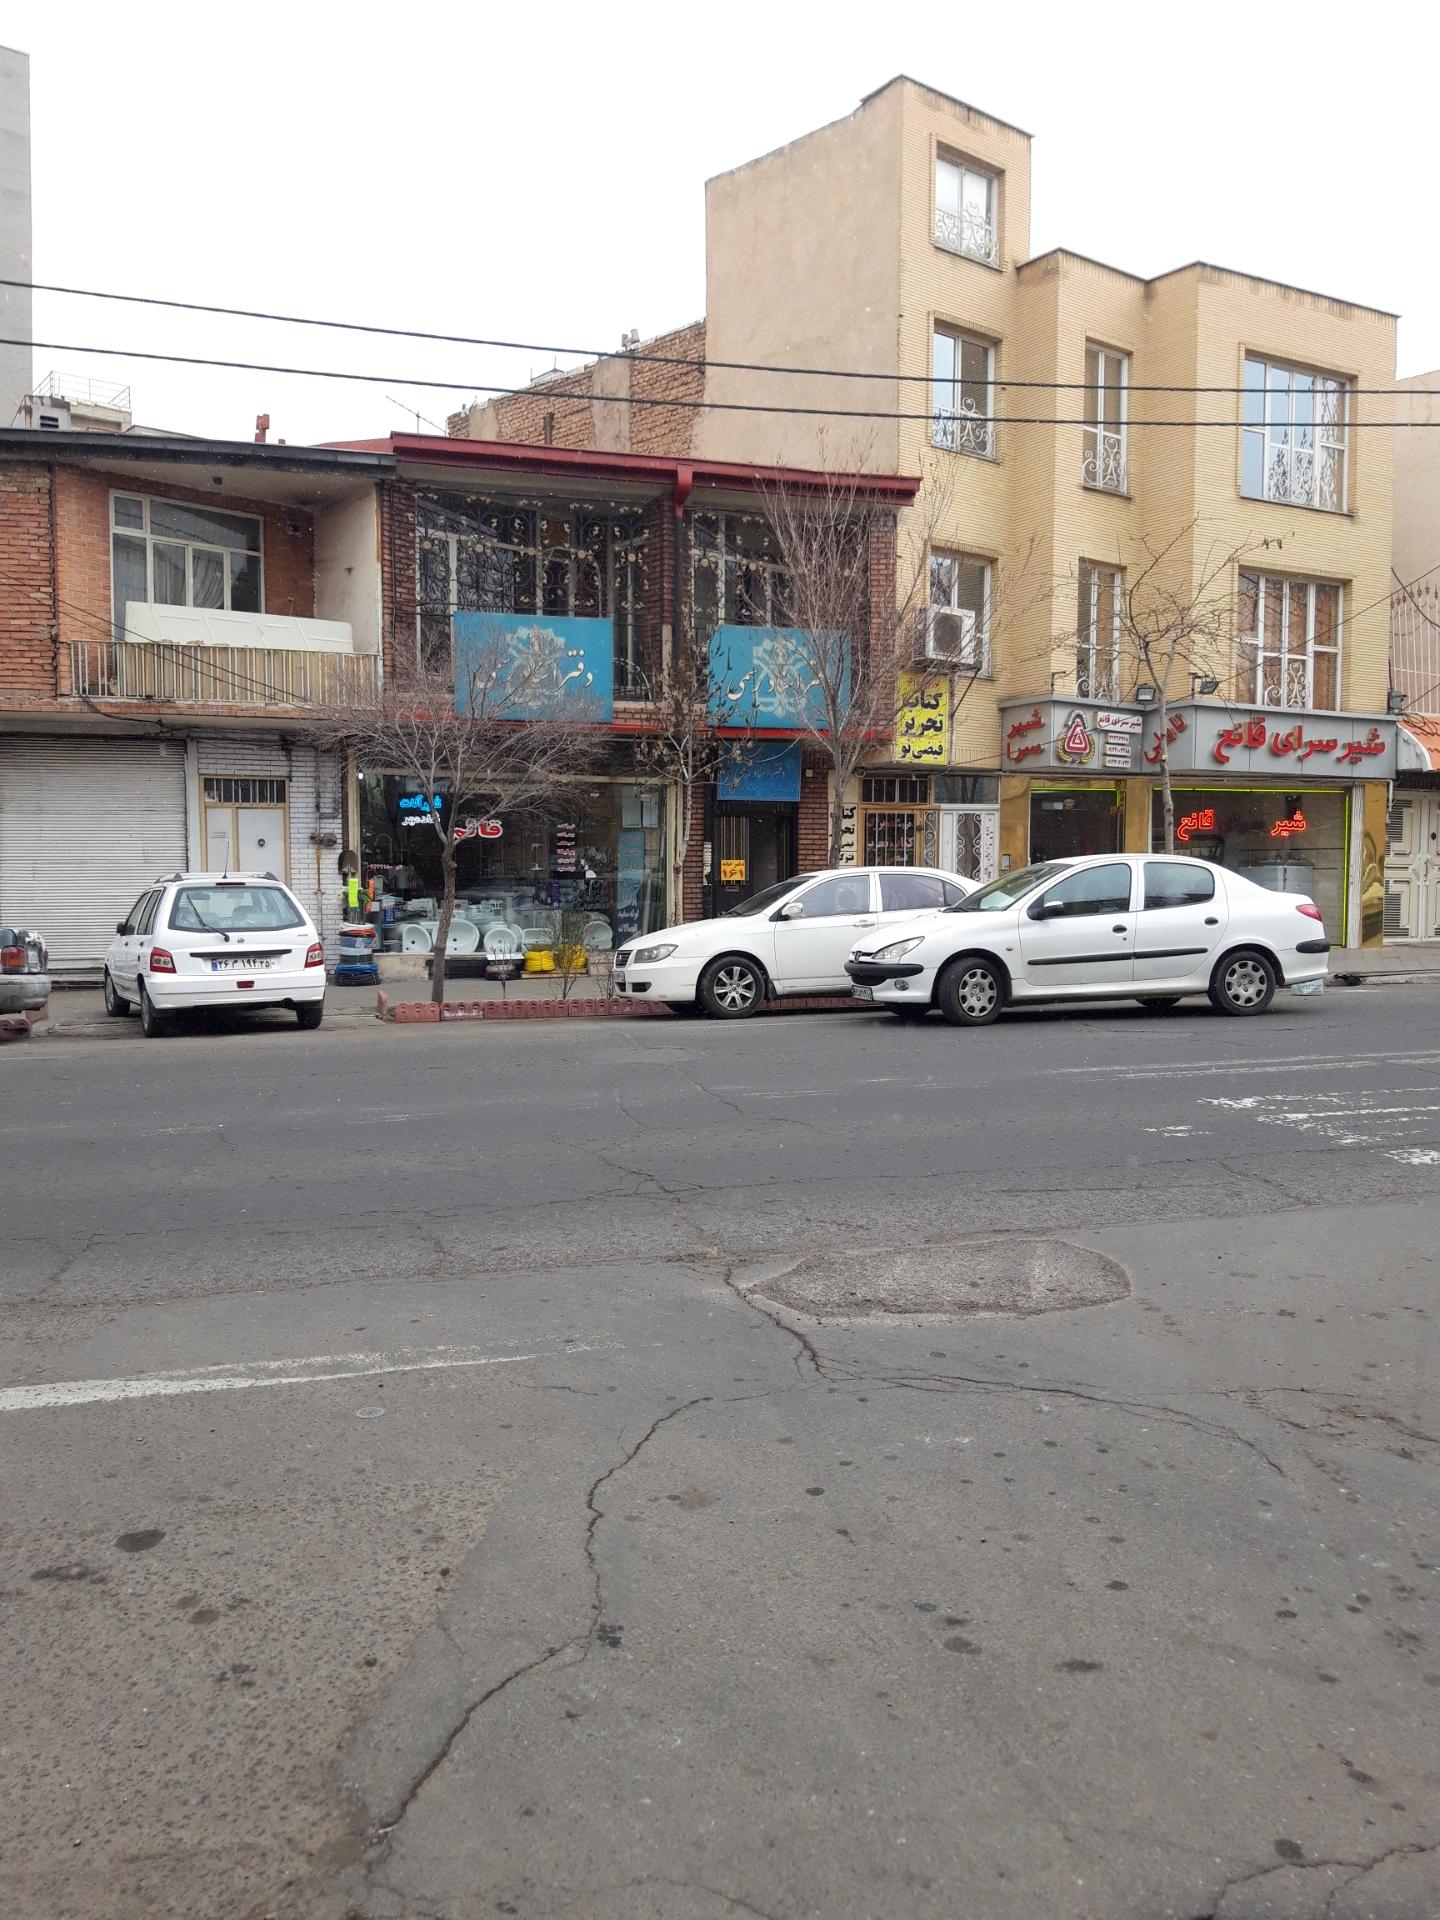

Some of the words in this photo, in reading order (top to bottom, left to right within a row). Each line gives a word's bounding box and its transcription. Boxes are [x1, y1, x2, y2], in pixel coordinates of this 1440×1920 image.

[551, 648, 594, 693] دفتر
[902, 688, 943, 713] کتاب
[902, 711, 944, 737] تحریر
[1006, 708, 1044, 739] شیر
[1129, 717, 1142, 729] شیر
[900, 738, 912, 759] نو
[1006, 742, 1043, 764] سرا
[1213, 716, 1268, 765] قانع
[1272, 724, 1338, 762] سرای
[1337, 727, 1387, 765] شیر
[842, 806, 856, 819] کتا
[1176, 807, 1215, 841] قانع
[1270, 809, 1307, 837] شیر
[453, 818, 503, 840] قائم
